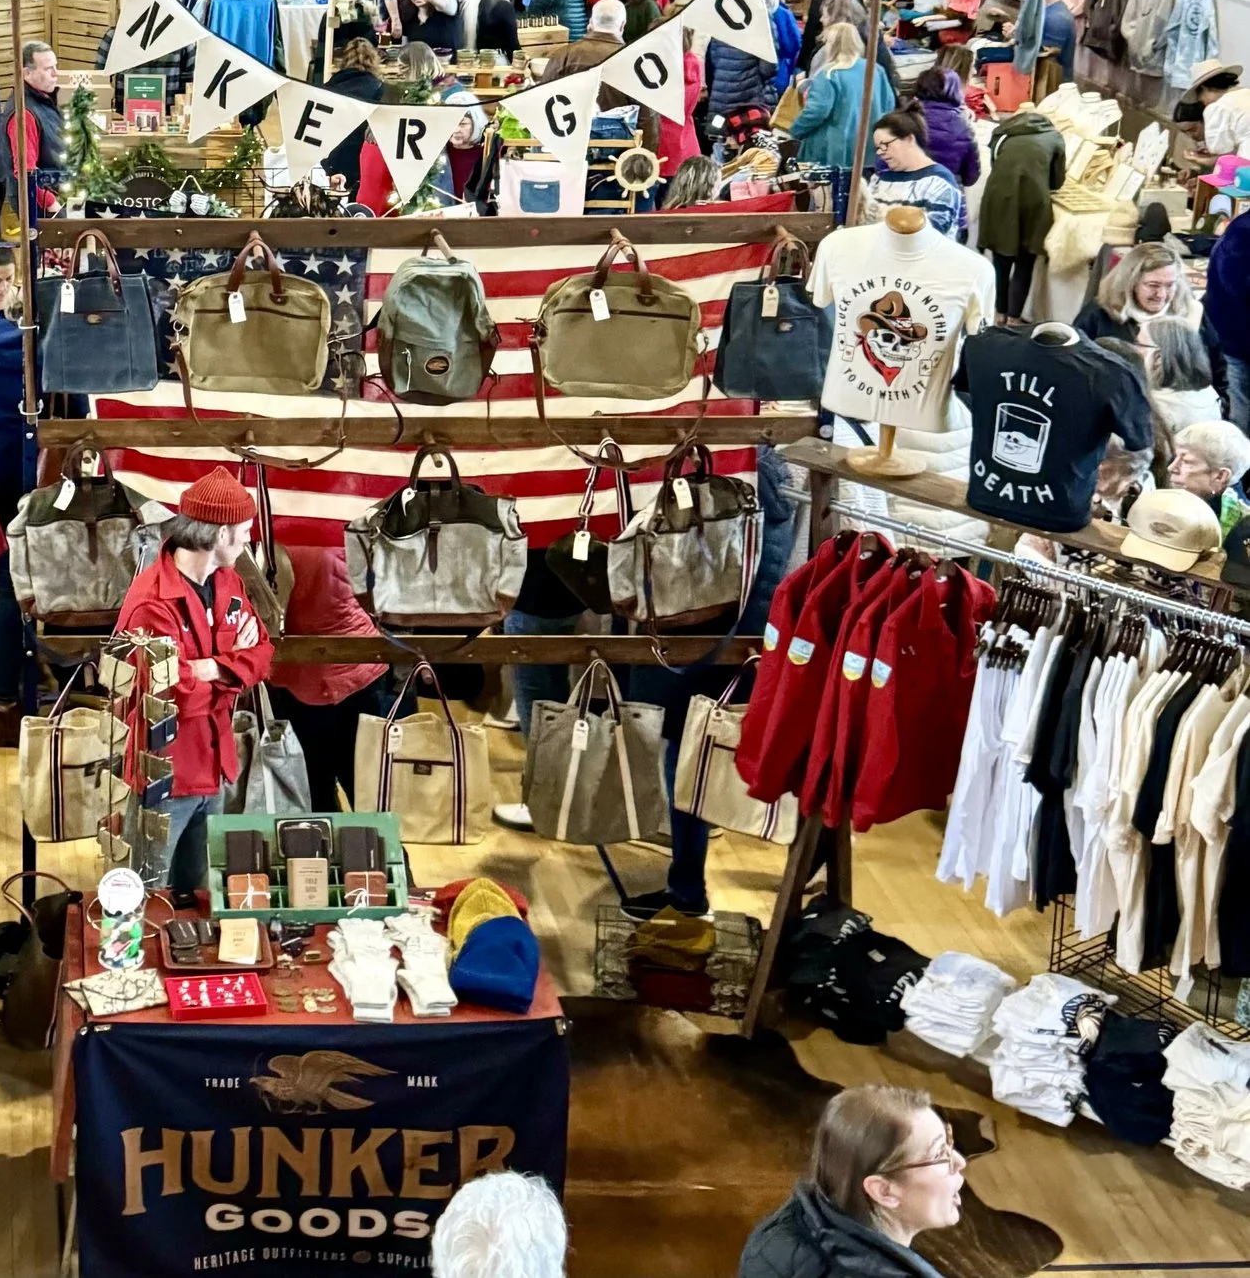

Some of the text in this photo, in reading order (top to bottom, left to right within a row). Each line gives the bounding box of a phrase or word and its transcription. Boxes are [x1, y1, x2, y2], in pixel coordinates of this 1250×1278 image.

[838, 297, 852, 327] LUCK
[851, 276, 887, 298] AINT
[894, 278, 921, 296] GOT
[843, 367, 927, 401] TO DO WITH IT
[1000, 371, 1055, 407] TILL
[974, 459, 1055, 504] DEATH
[204, 1075, 438, 1089] TRADE MARK
[121, 1124, 516, 1216] HUNKER
[204, 1203, 431, 1239] GOODS
[193, 1247, 256, 1271] HERITAGE
[262, 1247, 347, 1262] OUTFITTERS
